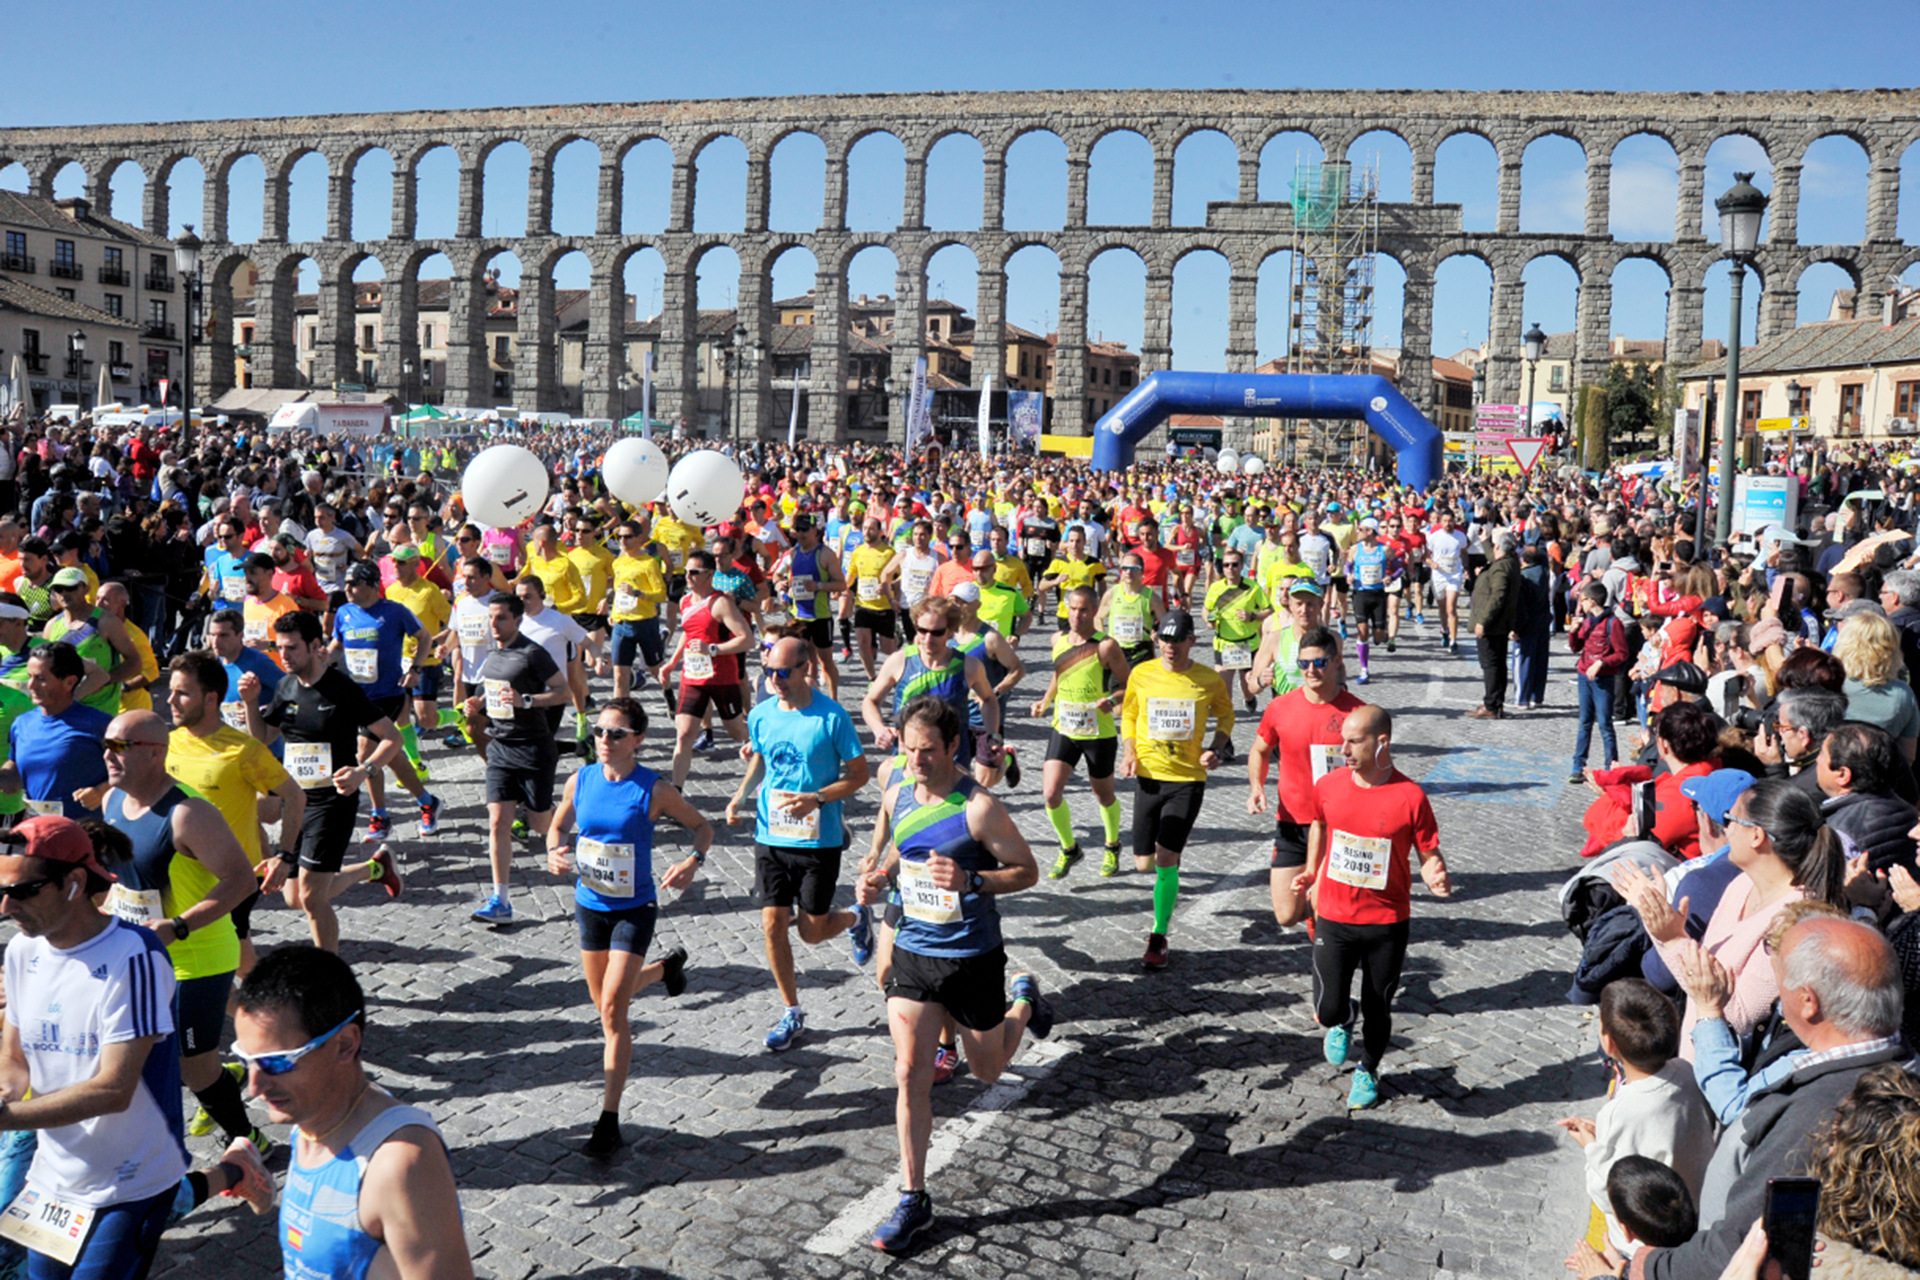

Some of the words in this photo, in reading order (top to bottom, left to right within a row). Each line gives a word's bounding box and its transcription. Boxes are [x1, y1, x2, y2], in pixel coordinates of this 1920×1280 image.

[332, 419, 370, 428] TABANERA
[1161, 719, 1181, 728] 2073
[1343, 847, 1374, 860] RESINO
[596, 857, 609, 867] ALI
[1343, 859, 1371, 874] 2049
[39, 1201, 72, 1229] 1143
